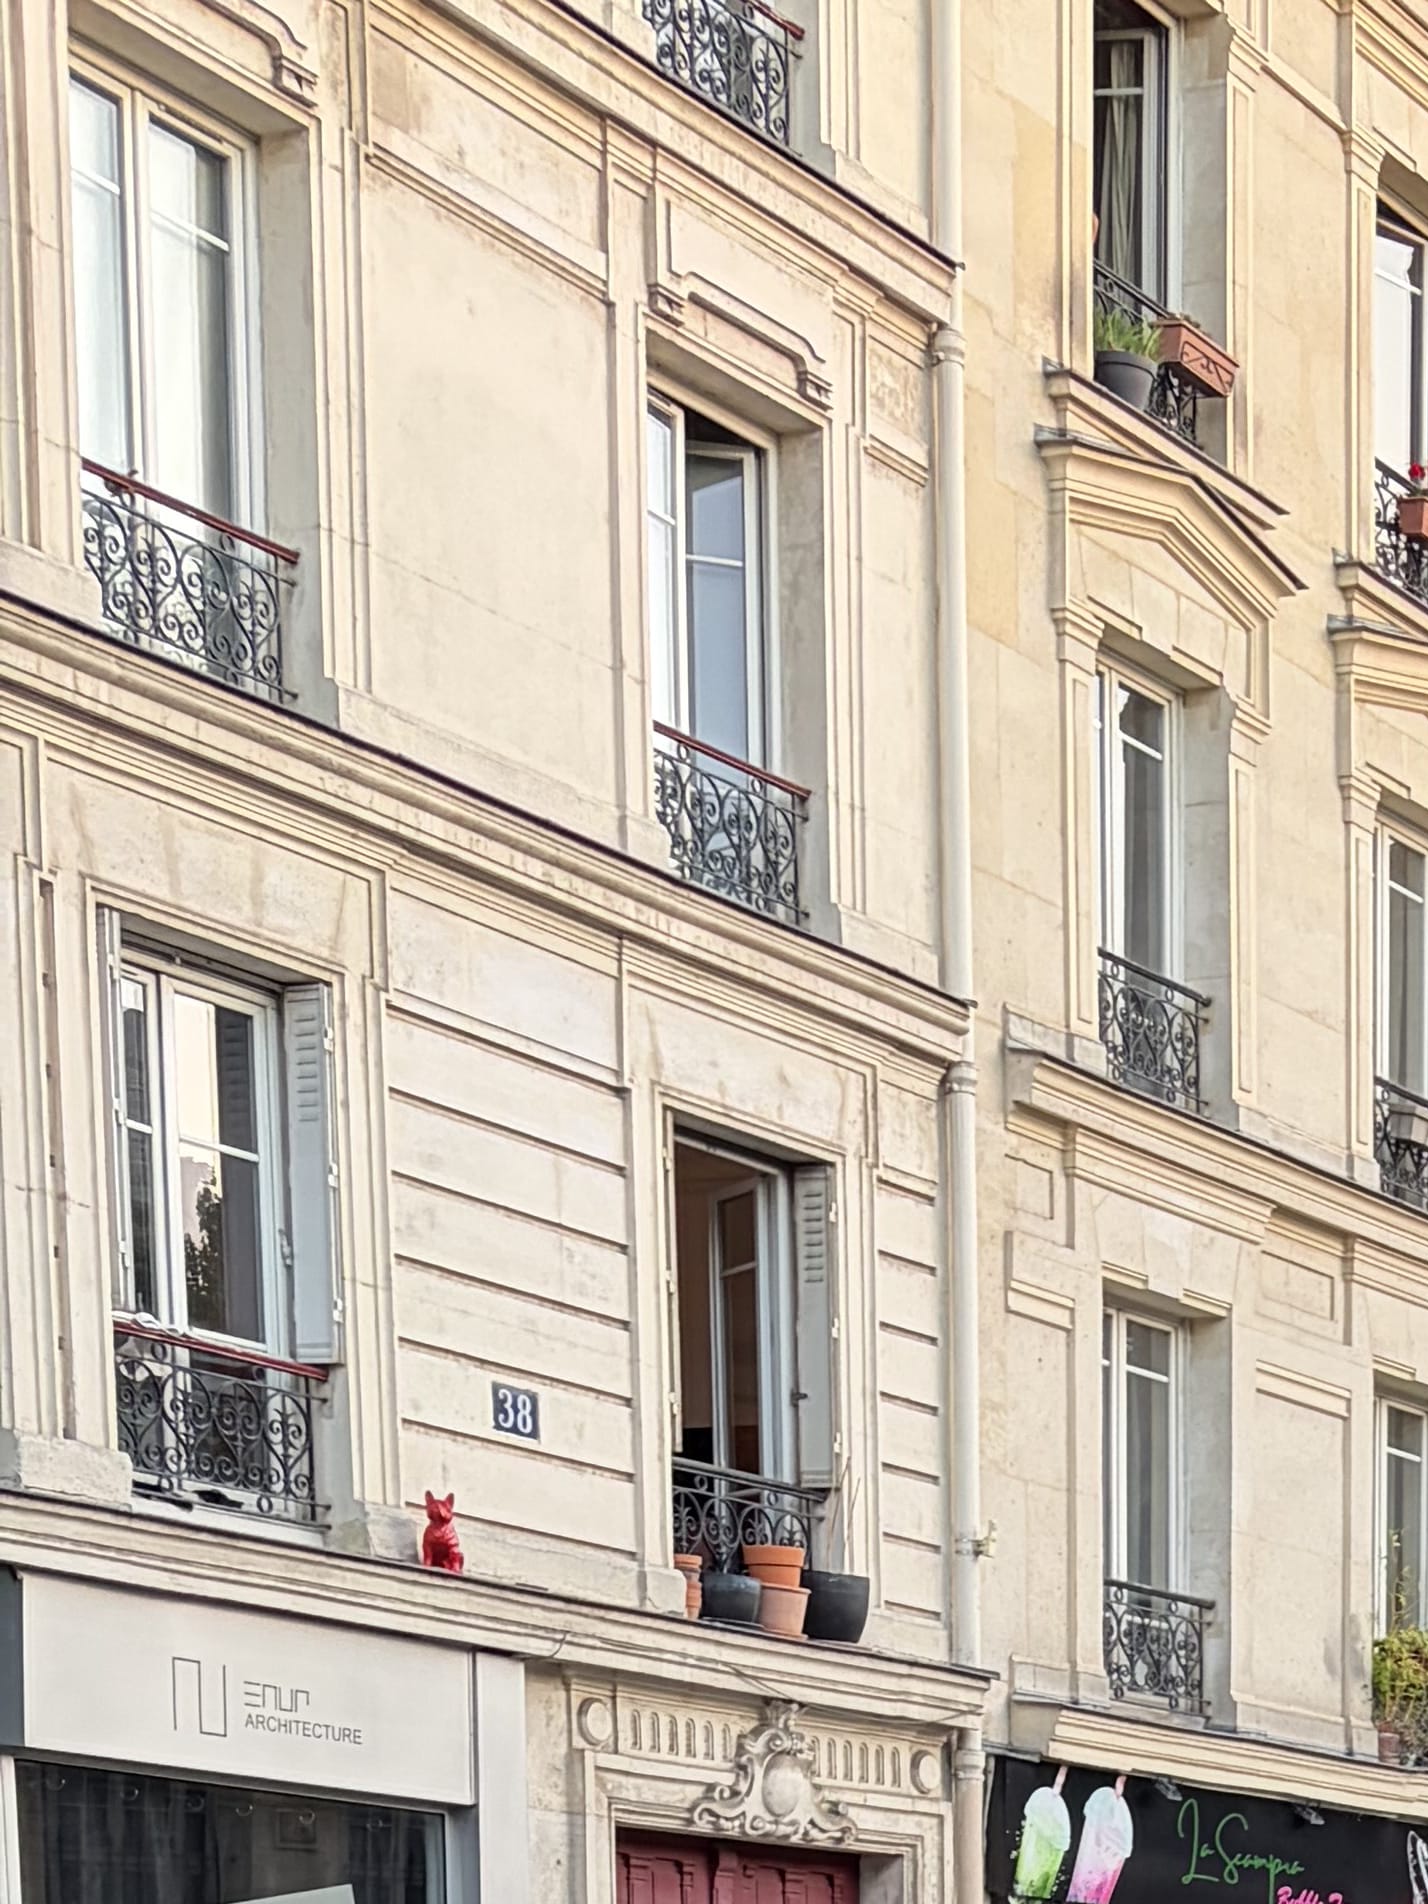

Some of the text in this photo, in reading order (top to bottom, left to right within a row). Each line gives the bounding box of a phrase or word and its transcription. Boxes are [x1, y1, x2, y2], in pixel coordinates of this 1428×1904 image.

[498, 1388, 533, 1434] 38
[244, 1713, 363, 1745] ARCHITECTURE
[1177, 1797, 1219, 1885] La
